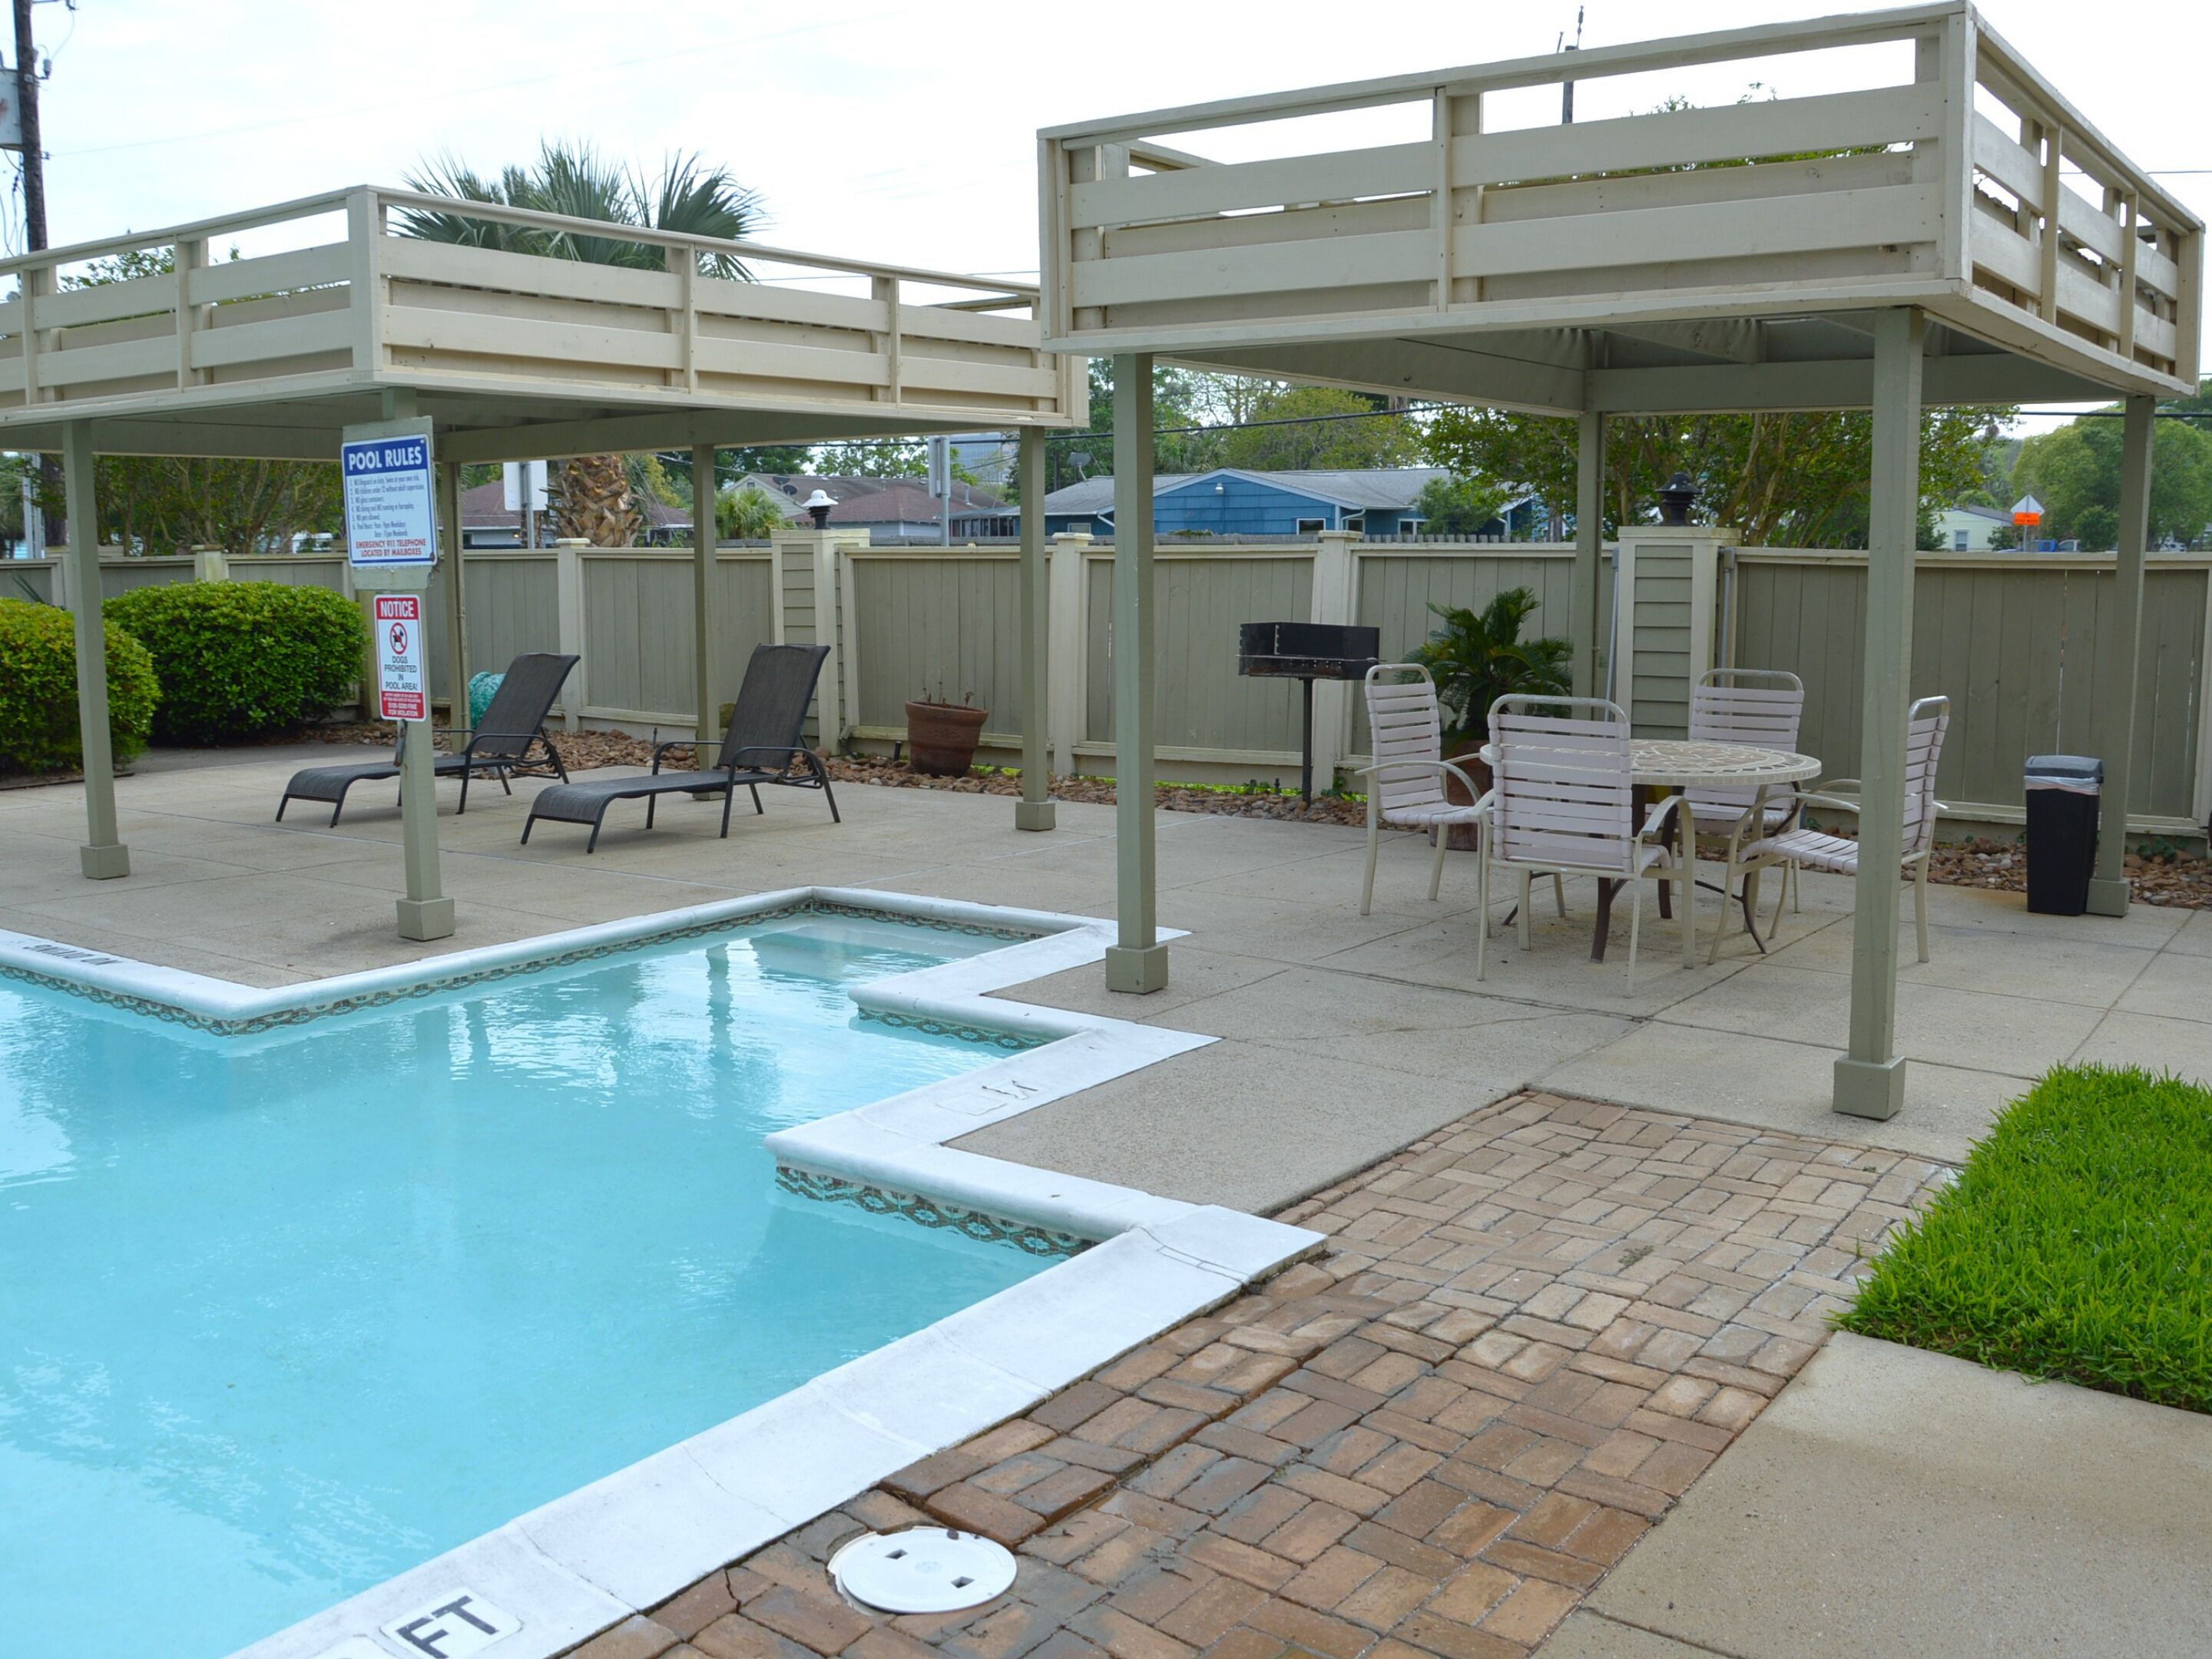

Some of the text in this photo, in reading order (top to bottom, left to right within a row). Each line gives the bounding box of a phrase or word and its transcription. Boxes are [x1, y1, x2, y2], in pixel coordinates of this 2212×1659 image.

[348, 446, 422, 470] POOL RULES
[396, 538, 426, 547] TELEPHONE
[380, 601, 415, 618] NOTICE
[392, 656, 409, 664] DOGS
[384, 664, 417, 673] PROHIBITED
[402, 682, 418, 690] AREA!
[396, 1595, 499, 1659] FT
